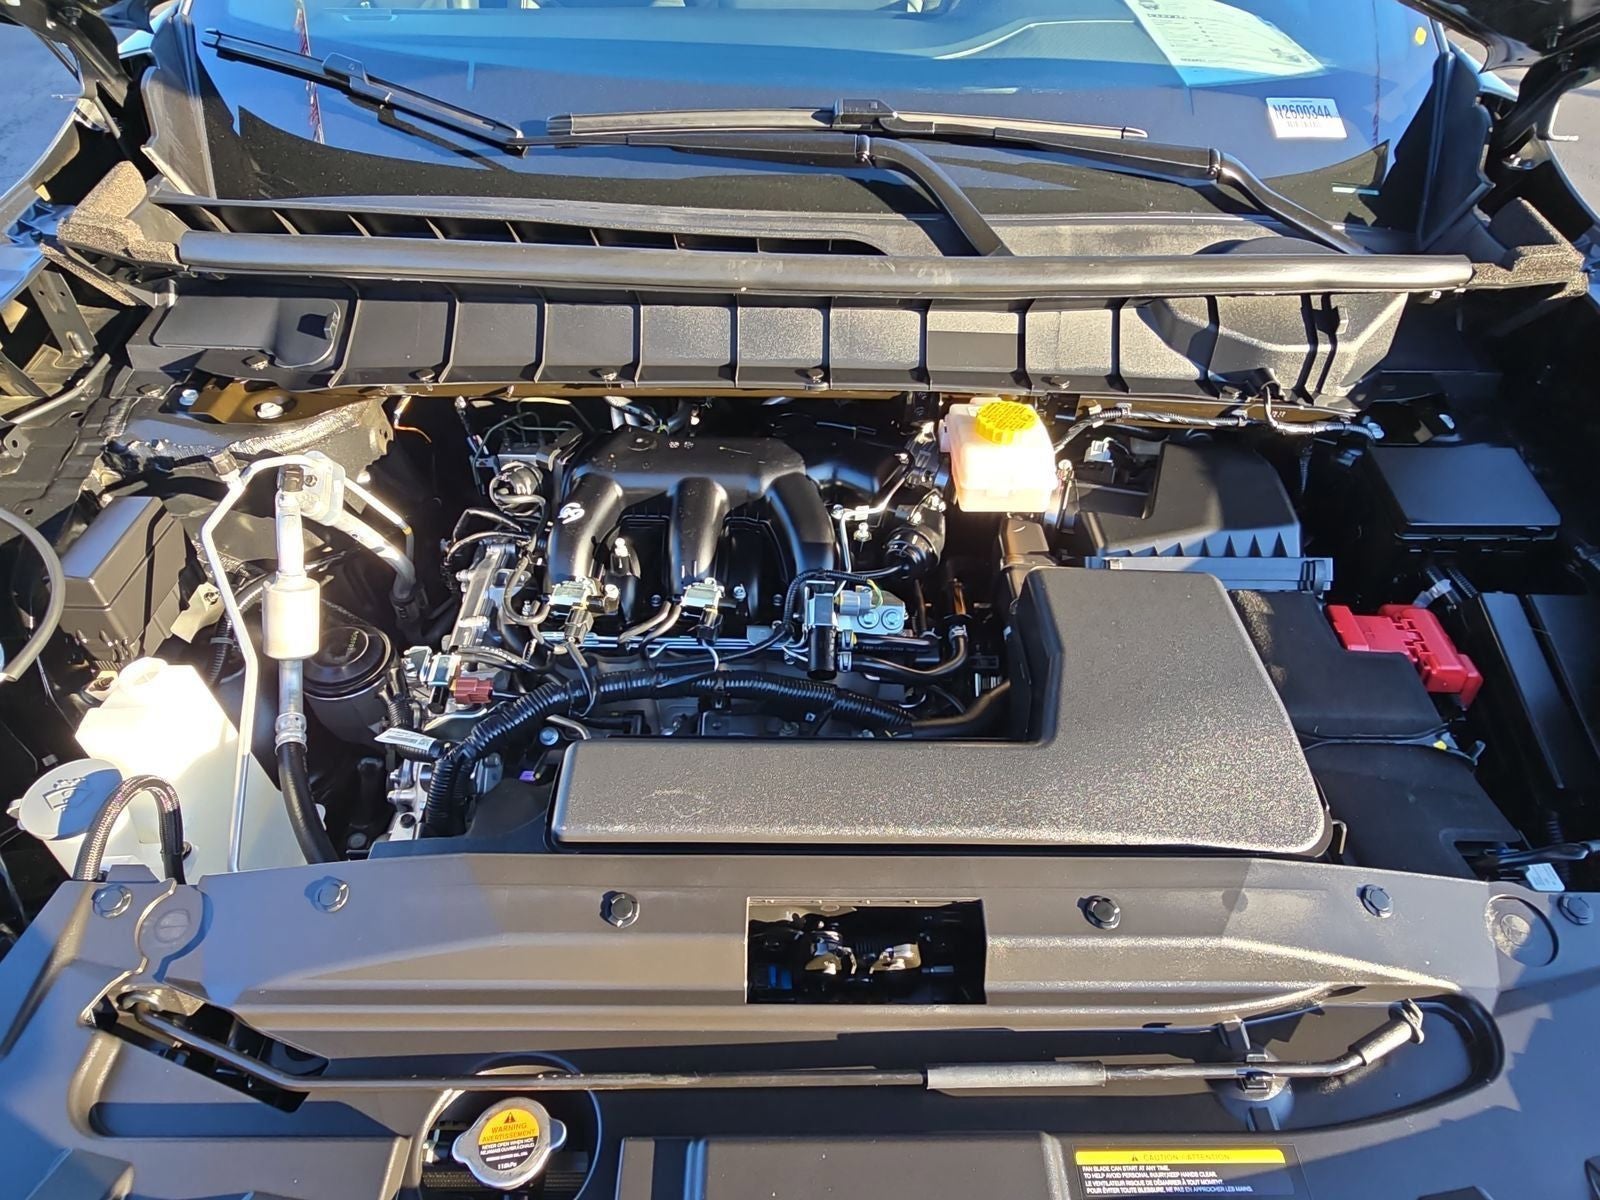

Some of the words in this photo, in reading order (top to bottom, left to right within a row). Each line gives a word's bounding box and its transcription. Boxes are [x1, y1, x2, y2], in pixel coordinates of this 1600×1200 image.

[1273, 104, 1333, 119] N260034A
[491, 1122, 527, 1134] WARNING
[482, 1128, 536, 1142] AVERTISSEMENT
[1143, 1153, 1179, 1161] CAUTION
[1186, 1152, 1230, 1160] ATTENTION
[1102, 1186, 1120, 1194] ÉVITER
